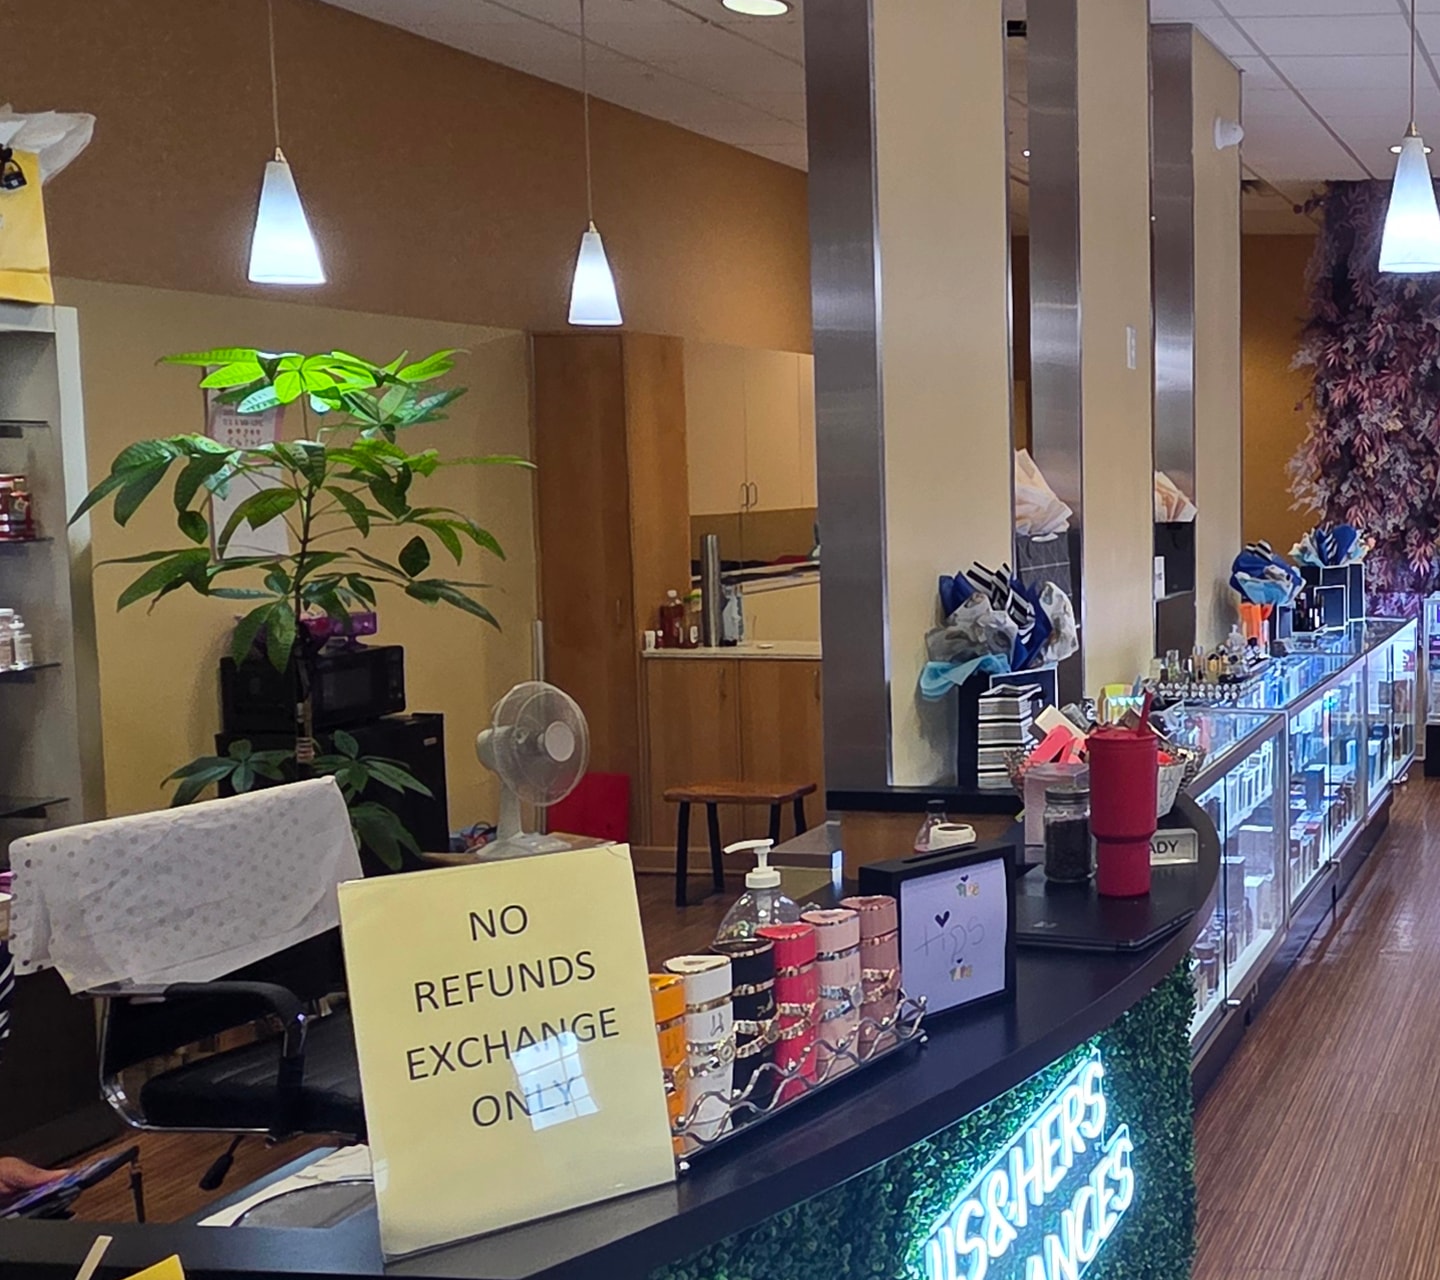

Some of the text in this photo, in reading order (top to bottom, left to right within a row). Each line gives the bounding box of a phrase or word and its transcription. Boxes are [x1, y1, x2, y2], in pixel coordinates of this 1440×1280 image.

[469, 904, 528, 941] NO
[414, 951, 596, 1013] REFUNDS
[406, 1007, 620, 1081] EXCHANGE
[472, 1076, 575, 1127] ONLY
